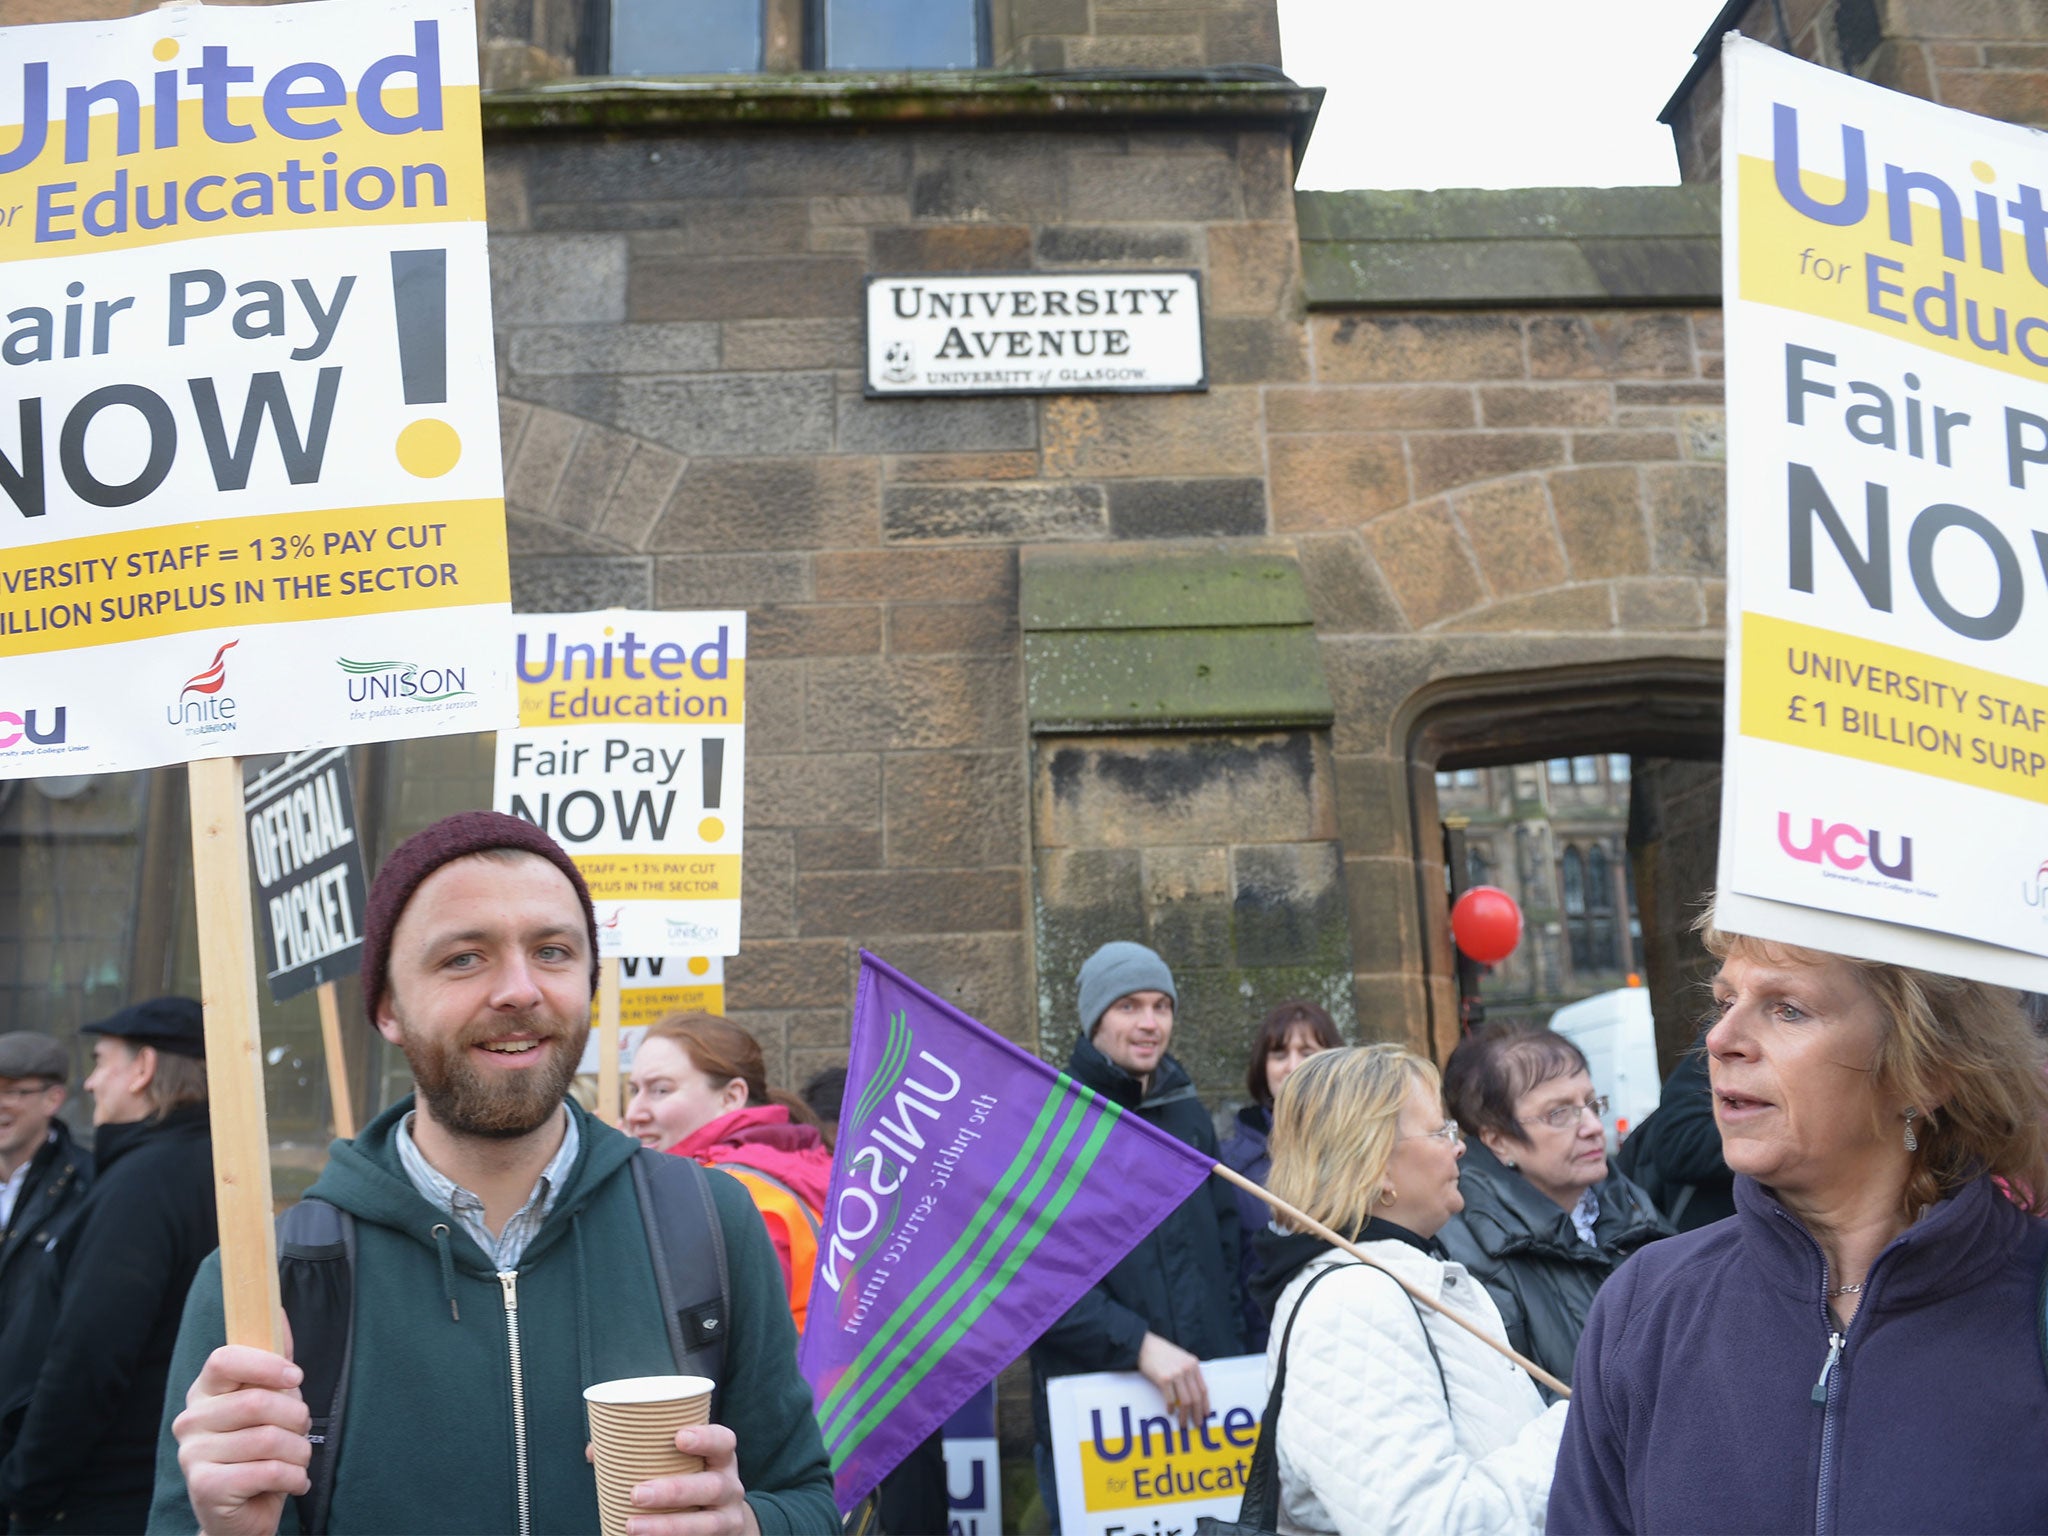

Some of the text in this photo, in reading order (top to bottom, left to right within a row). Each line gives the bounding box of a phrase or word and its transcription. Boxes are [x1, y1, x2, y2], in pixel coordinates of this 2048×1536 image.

[35, 151, 448, 243] Education
[1799, 248, 1851, 284] for
[168, 269, 357, 361] Pay
[890, 286, 1179, 319] UNIVERSITY
[935, 327, 1131, 359] AVENUE
[927, 370, 1031, 383] UNIVERSITY
[1039, 368, 1051, 386] of
[1785, 342, 1971, 468] Fair
[0, 557, 117, 594] VERSITY
[127, 544, 209, 577] STAFF
[324, 529, 377, 555] PAY
[386, 524, 446, 549] CUT
[1788, 461, 2048, 641] NO
[101, 583, 225, 623] SURPLUS
[236, 579, 264, 604] IN
[273, 574, 331, 600] THE
[340, 563, 458, 596] SECTOR
[516, 625, 728, 684] United
[167, 696, 235, 725] unite
[349, 667, 465, 702] UNISON
[350, 700, 478, 720] the public service union
[522, 687, 727, 718] for Education
[1788, 648, 2047, 733] UNIVERSITY STAF
[512, 739, 685, 785] Fair Pay
[1788, 695, 2046, 777] £1 BILLION SURP
[250, 767, 354, 888] OFFICIAL
[511, 790, 676, 843] NOW
[581, 864, 615, 874] STAFF
[663, 864, 686, 873] PAY
[689, 864, 716, 874] CUT
[1777, 811, 1913, 882] ucu
[624, 882, 638, 891] IN
[642, 882, 664, 892] THE
[669, 881, 719, 892] SECTOR
[269, 862, 357, 973] PICKET
[1091, 1406, 1260, 1463] Unite
[1106, 1457, 1253, 1499] for Educat
